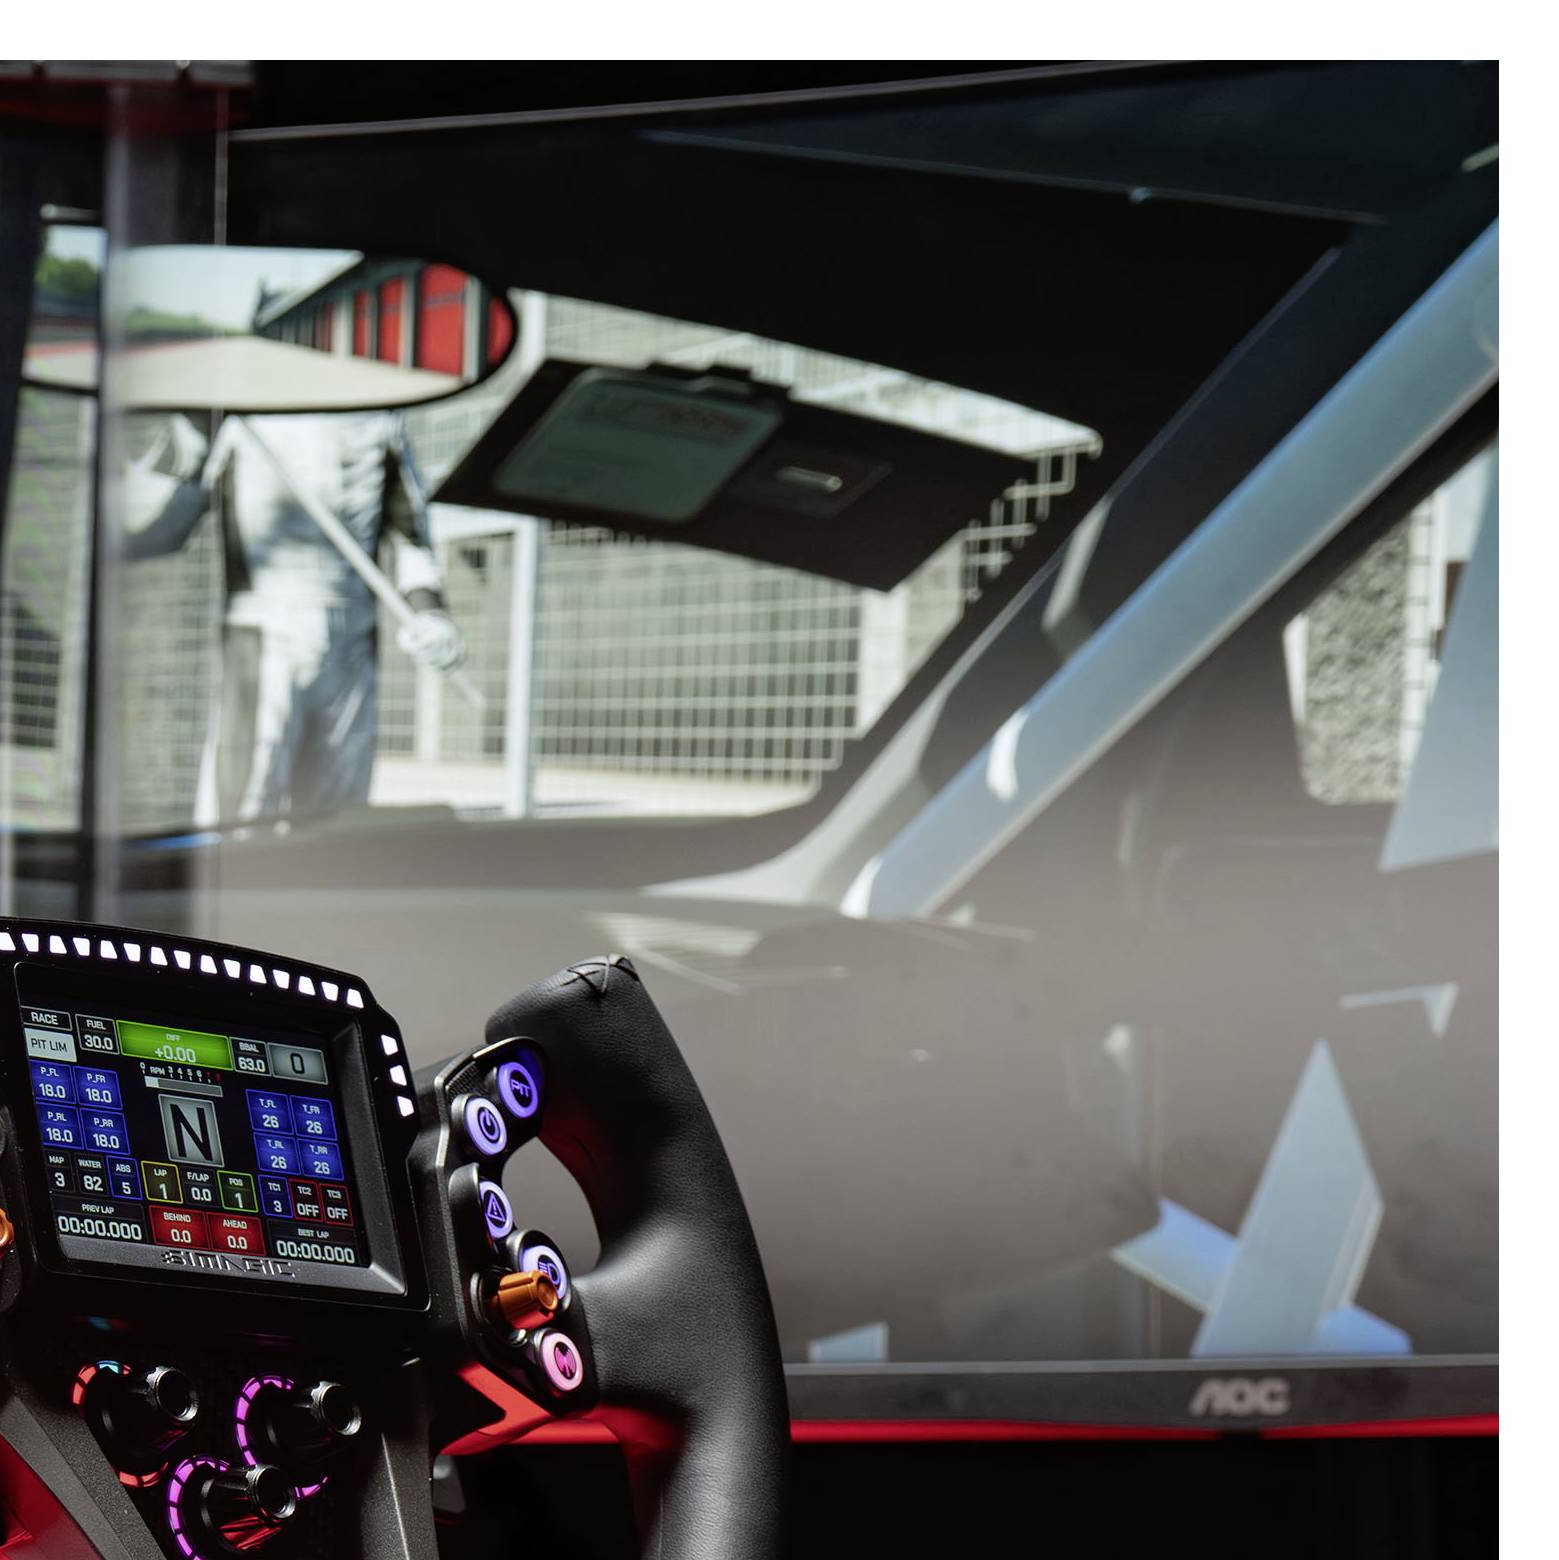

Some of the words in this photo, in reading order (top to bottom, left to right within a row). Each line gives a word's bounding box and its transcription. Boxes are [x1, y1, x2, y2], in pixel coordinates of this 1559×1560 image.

[31, 1012, 59, 1025] RACE
[87, 1020, 107, 1031] FUEL
[31, 1038, 46, 1049] PIT
[50, 1040, 68, 1052] LIM
[84, 1035, 114, 1051] 30.0
[155, 1045, 197, 1063] +0.00
[238, 1057, 266, 1073] 63.0
[291, 1053, 305, 1074] 0
[41, 1067, 60, 1078] P_FL
[150, 1066, 166, 1076] RPM
[87, 1073, 106, 1084] P_FR
[39, 1083, 66, 1099] 18.0
[511, 1079, 531, 1098] PIT
[86, 1088, 112, 1104] 18.0
[259, 1098, 277, 1109] T_FL
[47, 1111, 68, 1122] P_RL
[93, 1117, 114, 1128] P_RR
[262, 1115, 280, 1129] 26
[46, 1127, 74, 1143] 18.0
[170, 1104, 214, 1162] N
[306, 1121, 323, 1135] 26
[93, 1133, 120, 1149] 18.0
[49, 1156, 65, 1165] MAP
[78, 1159, 102, 1169] WATER
[270, 1155, 288, 1170] 26
[115, 1164, 132, 1173] ABS
[153, 1168, 168, 1177] LAP
[313, 1161, 331, 1175] 26
[54, 1172, 66, 1188] 3
[83, 1176, 104, 1192] 82
[187, 1172, 210, 1183] F/LAP
[229, 1178, 244, 1187] POS
[122, 1182, 132, 1195] 5
[159, 1184, 168, 1200] 1
[268, 1182, 281, 1192] TC1
[297, 1186, 313, 1196] TC2
[191, 1187, 212, 1202] 0.0
[234, 1193, 244, 1209] 1
[82, 1204, 100, 1214] PREV
[101, 1206, 115, 1215] LAP
[273, 1200, 283, 1213] 3
[297, 1203, 320, 1218] OFF
[163, 1212, 192, 1223] BEHIND
[327, 1207, 349, 1221] OFF
[58, 1216, 143, 1241] 00:00.000
[223, 1219, 248, 1230] AHEAD
[170, 1229, 192, 1244] 0.0
[298, 1228, 315, 1238] BEST
[317, 1230, 330, 1239] LAP
[227, 1235, 248, 1250] 0.0
[276, 1240, 356, 1264] 00:00.000
[1187, 1377, 1290, 1417] AOC
